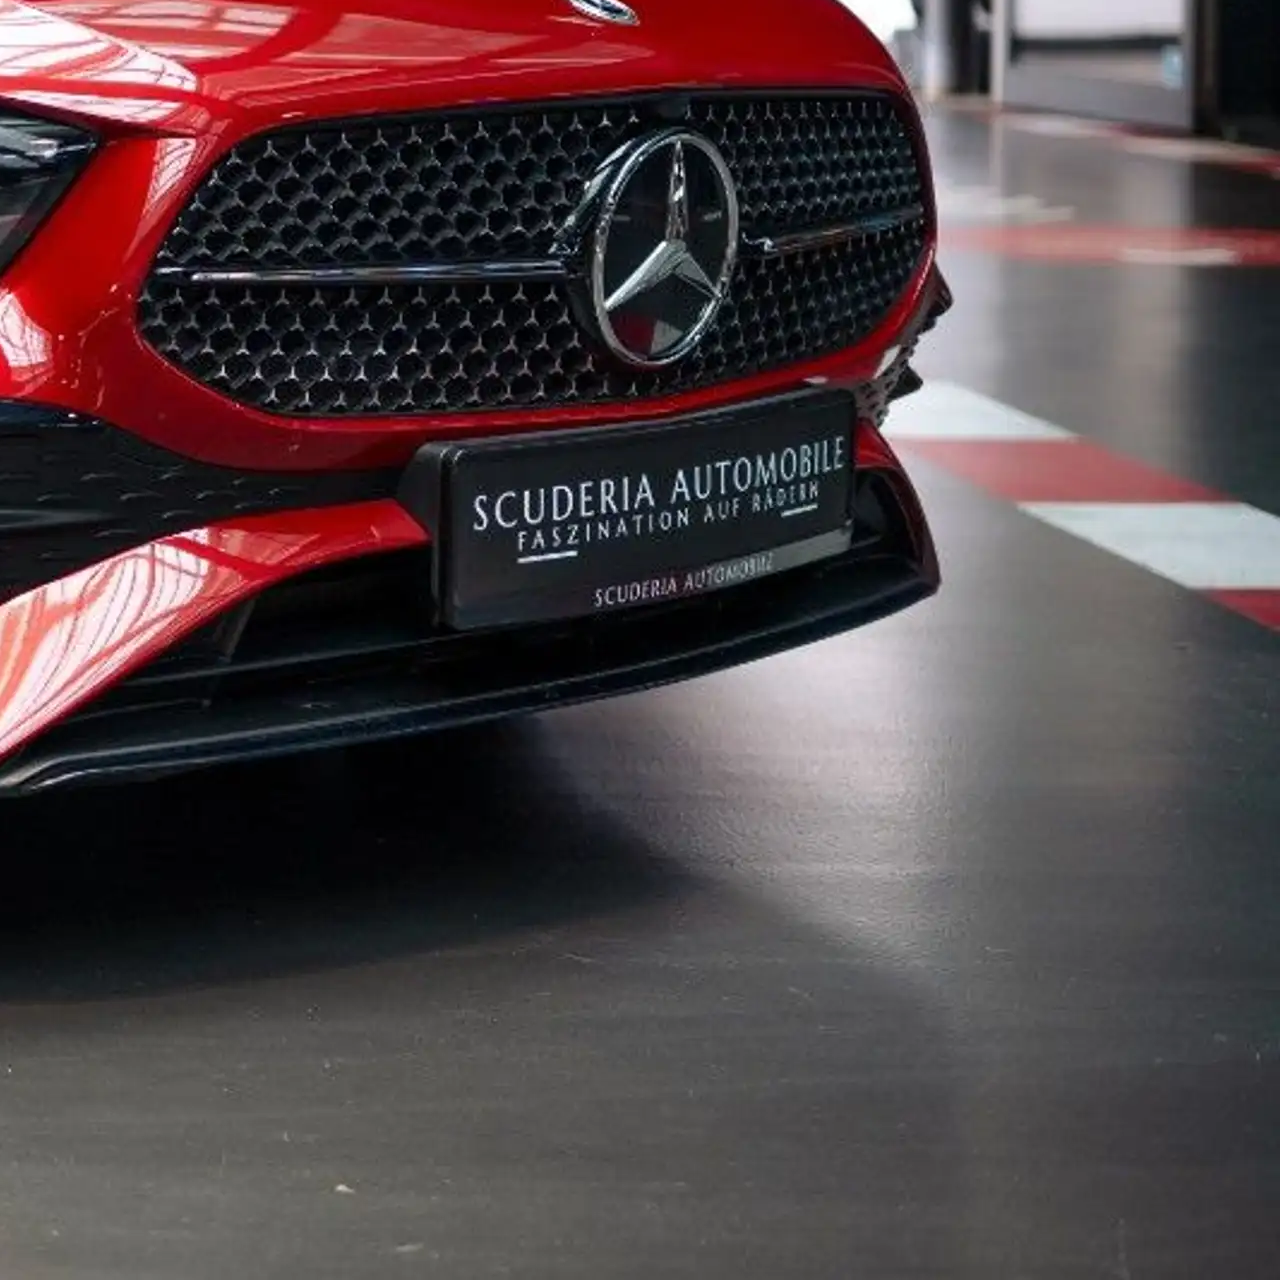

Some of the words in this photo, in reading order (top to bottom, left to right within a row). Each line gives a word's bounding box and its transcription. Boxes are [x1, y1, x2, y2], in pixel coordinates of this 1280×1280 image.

[472, 472, 656, 532] SCUDERIA
[669, 435, 845, 505] AUTOMOBILE
[517, 507, 690, 553] FASZINATION
[703, 496, 741, 524] AUF
[593, 576, 678, 608] SCUDERIA
